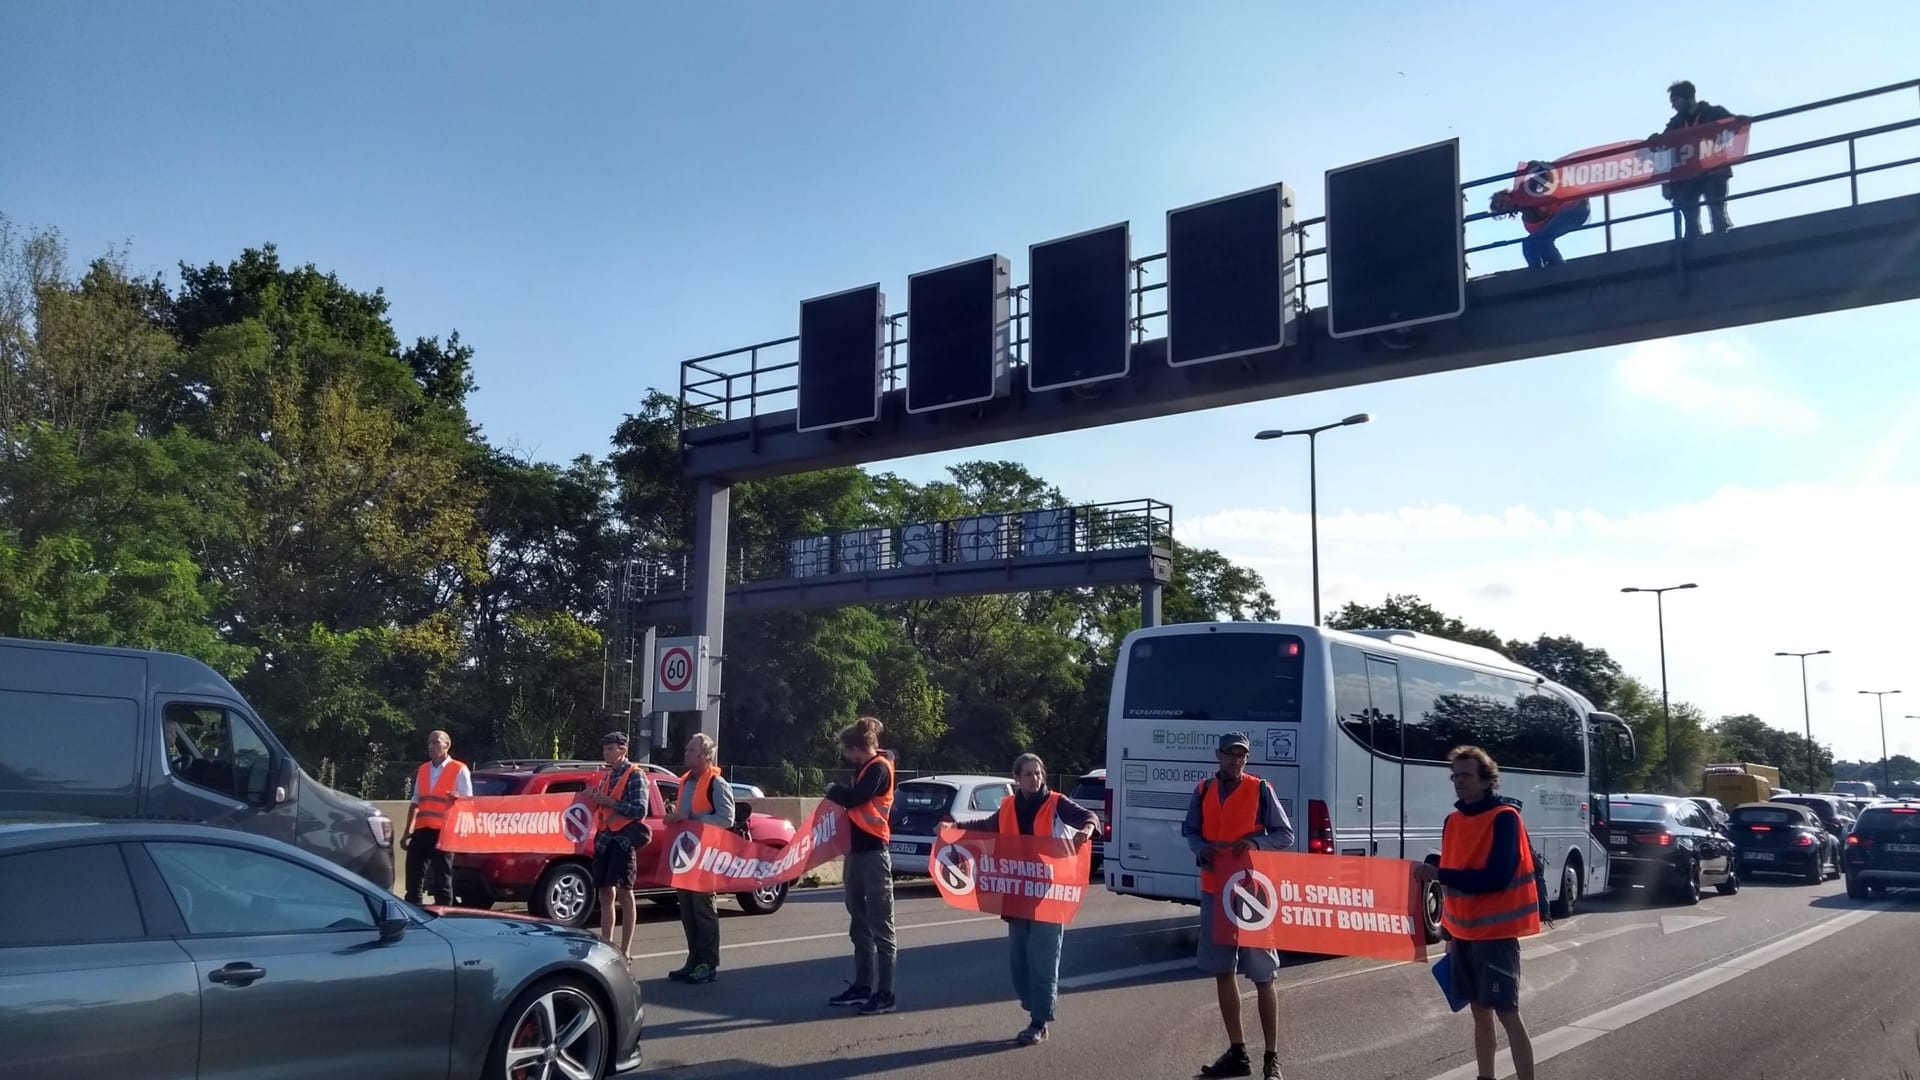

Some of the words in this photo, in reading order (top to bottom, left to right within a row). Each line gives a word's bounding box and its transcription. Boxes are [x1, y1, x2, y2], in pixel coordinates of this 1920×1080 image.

[667, 659, 685, 679] 60
[1152, 768, 1180, 781] 0800
[476, 811, 560, 838] NORDSEEÖL?
[979, 854, 997, 873] ÖL
[1000, 858, 1054, 880] SPAREN
[980, 876, 1021, 895] STATT
[1024, 880, 1081, 903] BOHREN
[1280, 880, 1301, 902] ÖL
[1305, 884, 1374, 908] SPAREN
[1281, 905, 1333, 928] STATT
[1337, 910, 1416, 935] BOHREN
